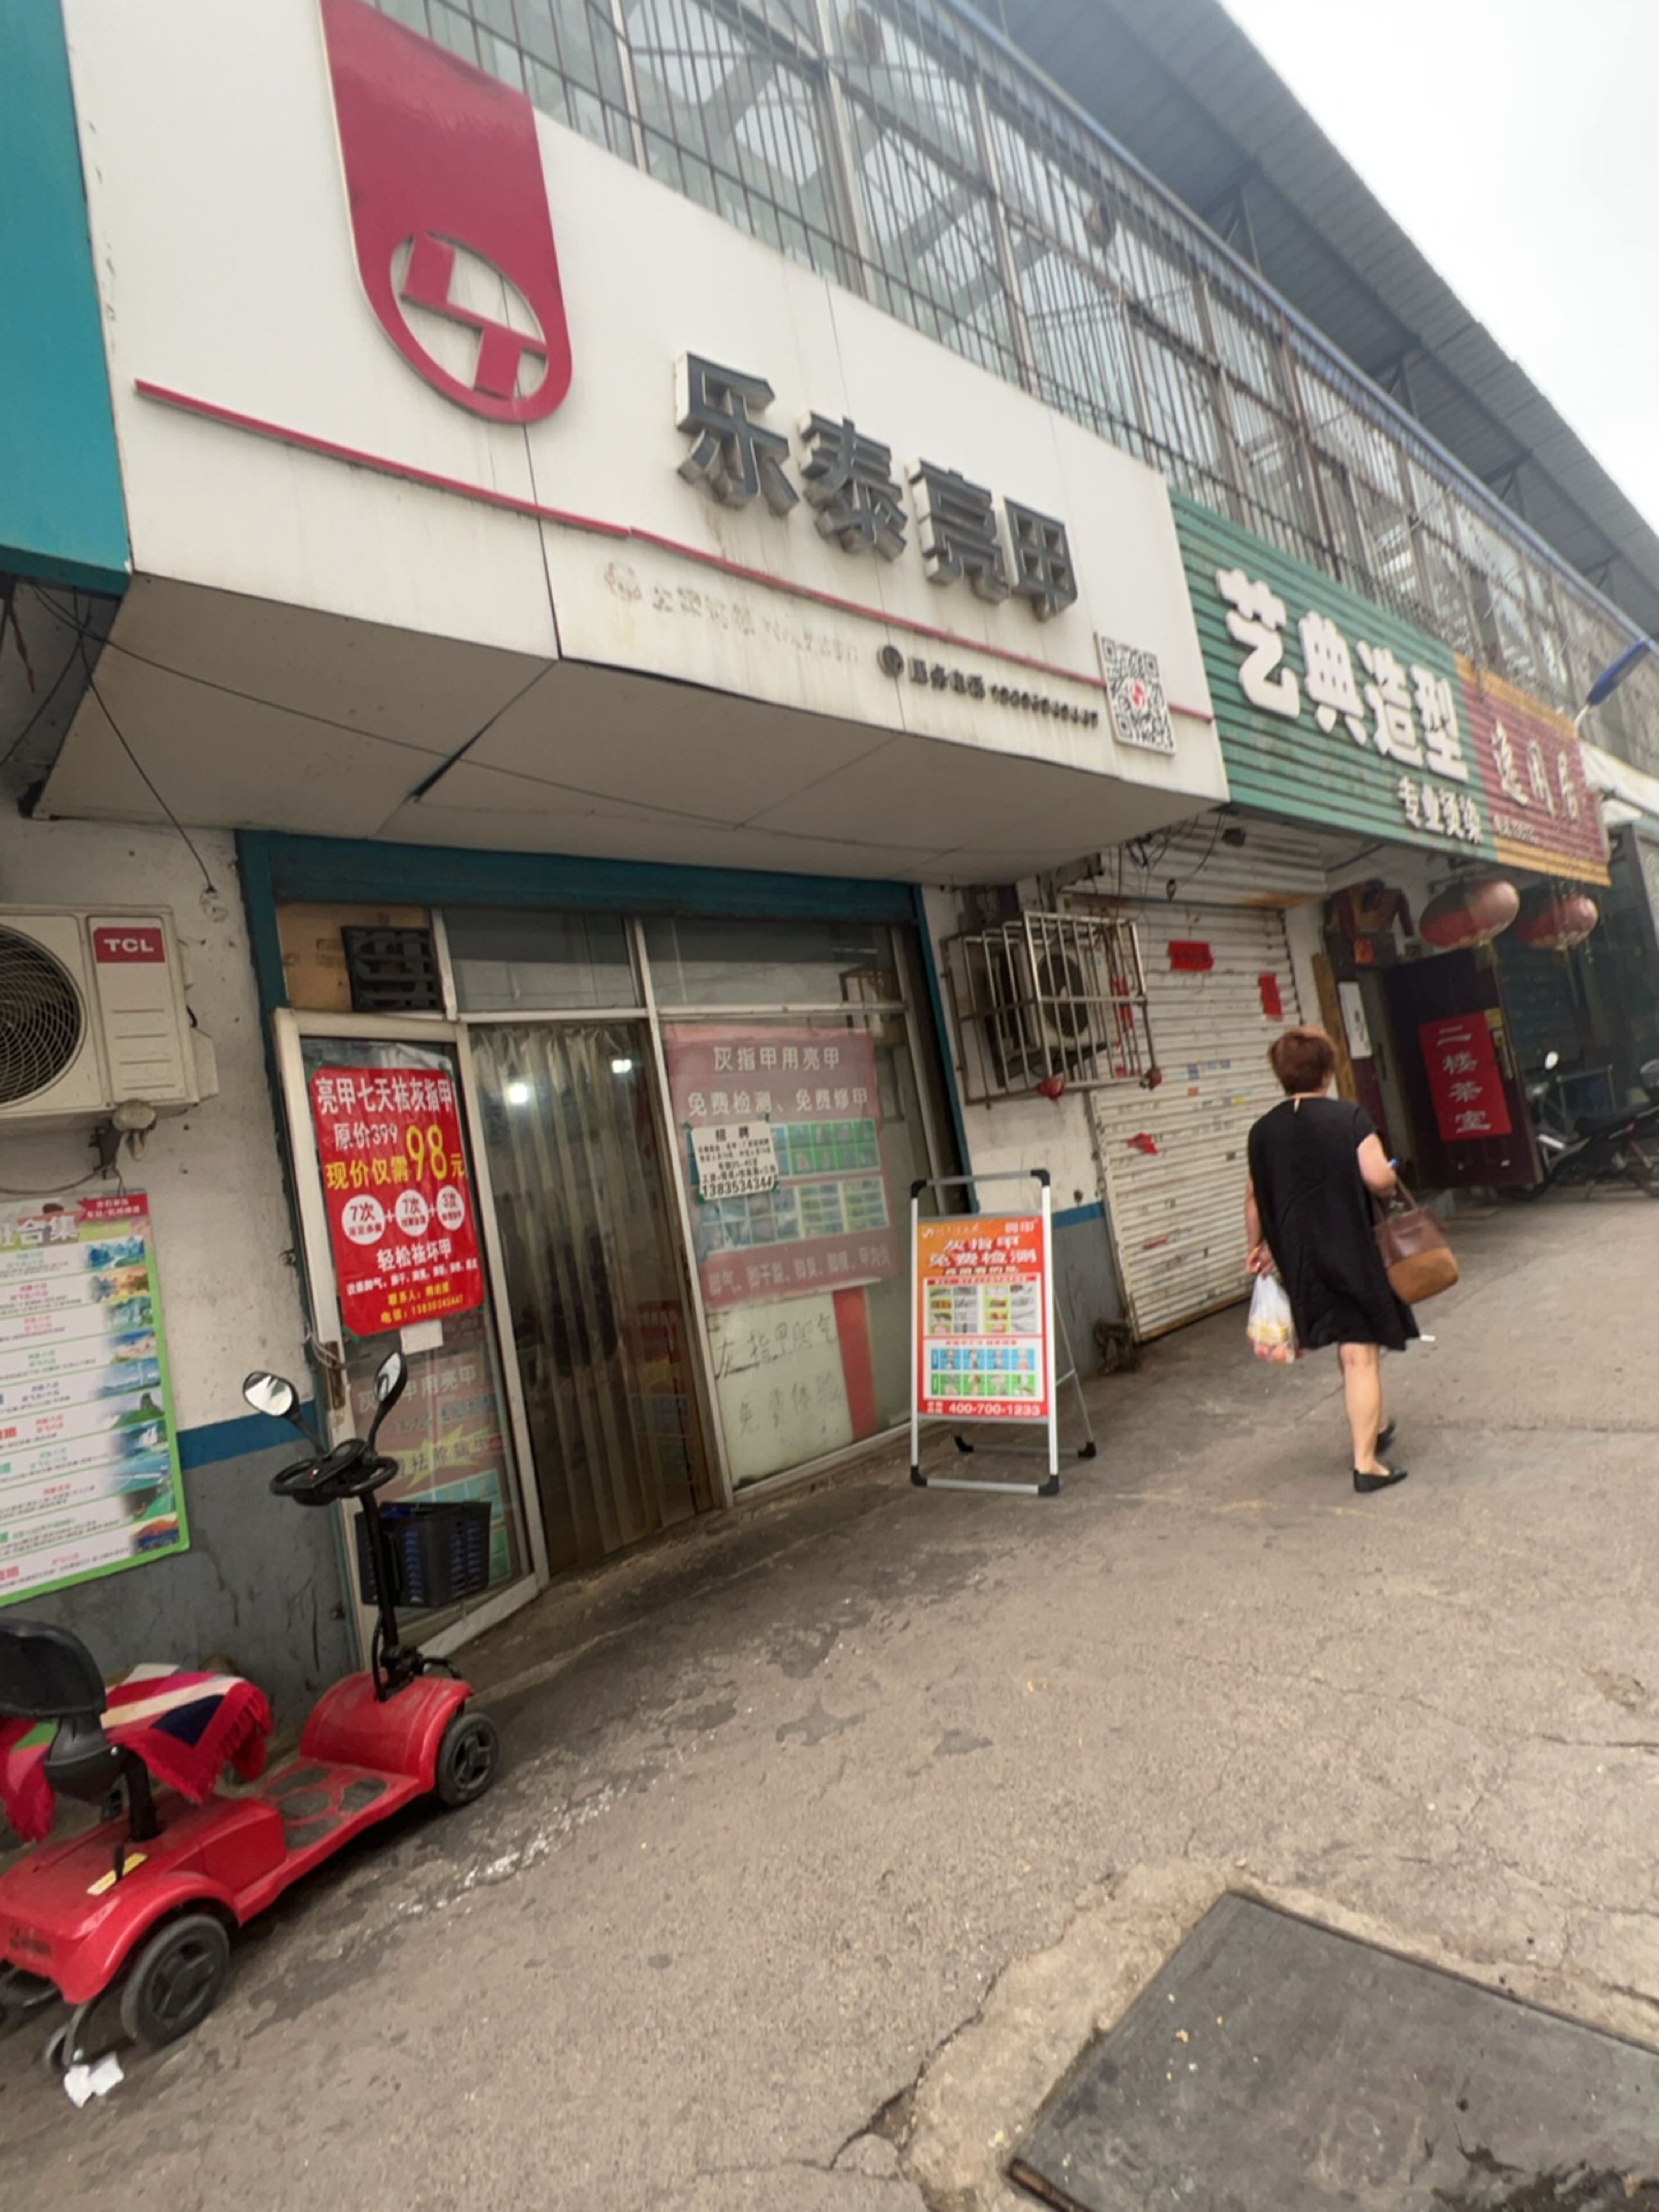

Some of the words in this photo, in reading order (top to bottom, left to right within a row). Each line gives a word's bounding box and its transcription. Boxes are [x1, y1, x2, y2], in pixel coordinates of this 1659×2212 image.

[675, 351, 1078, 621] 乐泰亮甲
[1216, 568, 1469, 782] 艺典造型
[104, 939, 154, 952] TCL
[713, 1046, 839, 1071] 灰指甲用亮甲
[1437, 1025, 1491, 1134] 二楼茶室
[316, 1077, 453, 1116] 亮甲七天祛灰指甲
[350, 1203, 375, 1222] 7次
[949, 1404, 1040, 1416] 400-700-1233
